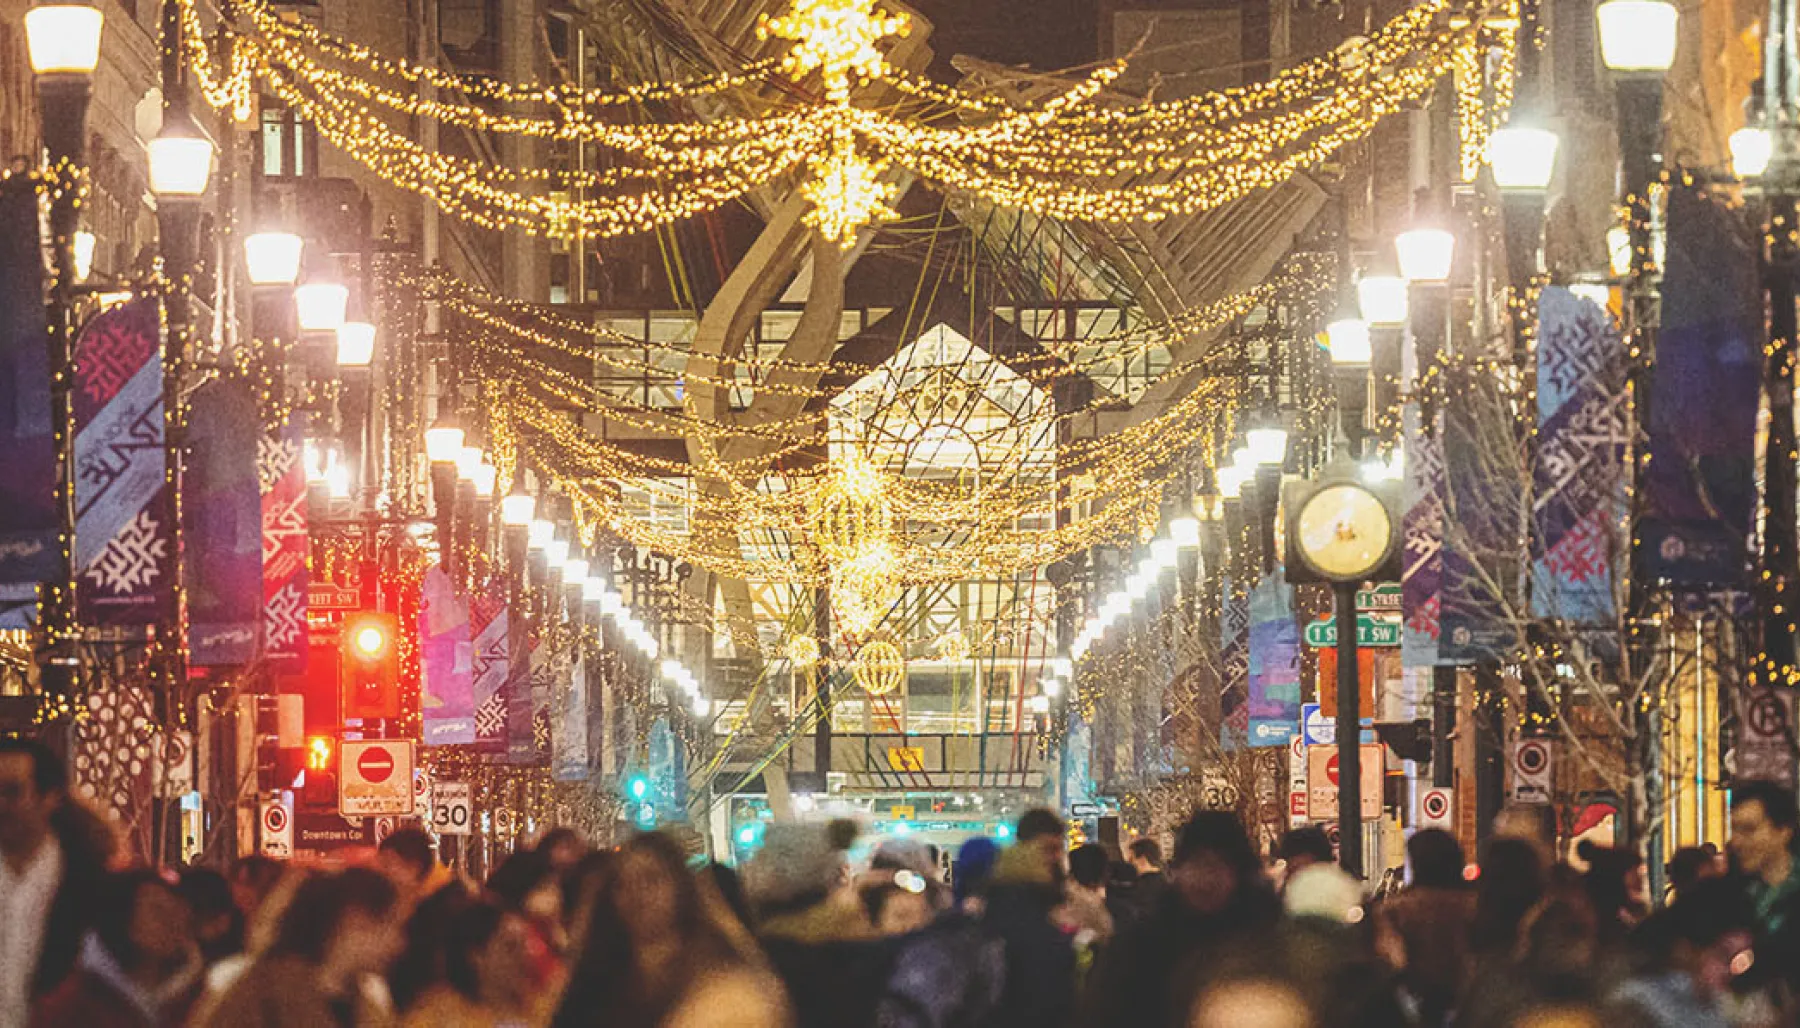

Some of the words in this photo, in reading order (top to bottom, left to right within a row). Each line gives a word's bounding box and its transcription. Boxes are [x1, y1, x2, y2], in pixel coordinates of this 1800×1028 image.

[1314, 627, 1321, 641] 1
[1372, 627, 1391, 641] SW
[1206, 787, 1235, 806] 30
[435, 804, 467, 826] 30
